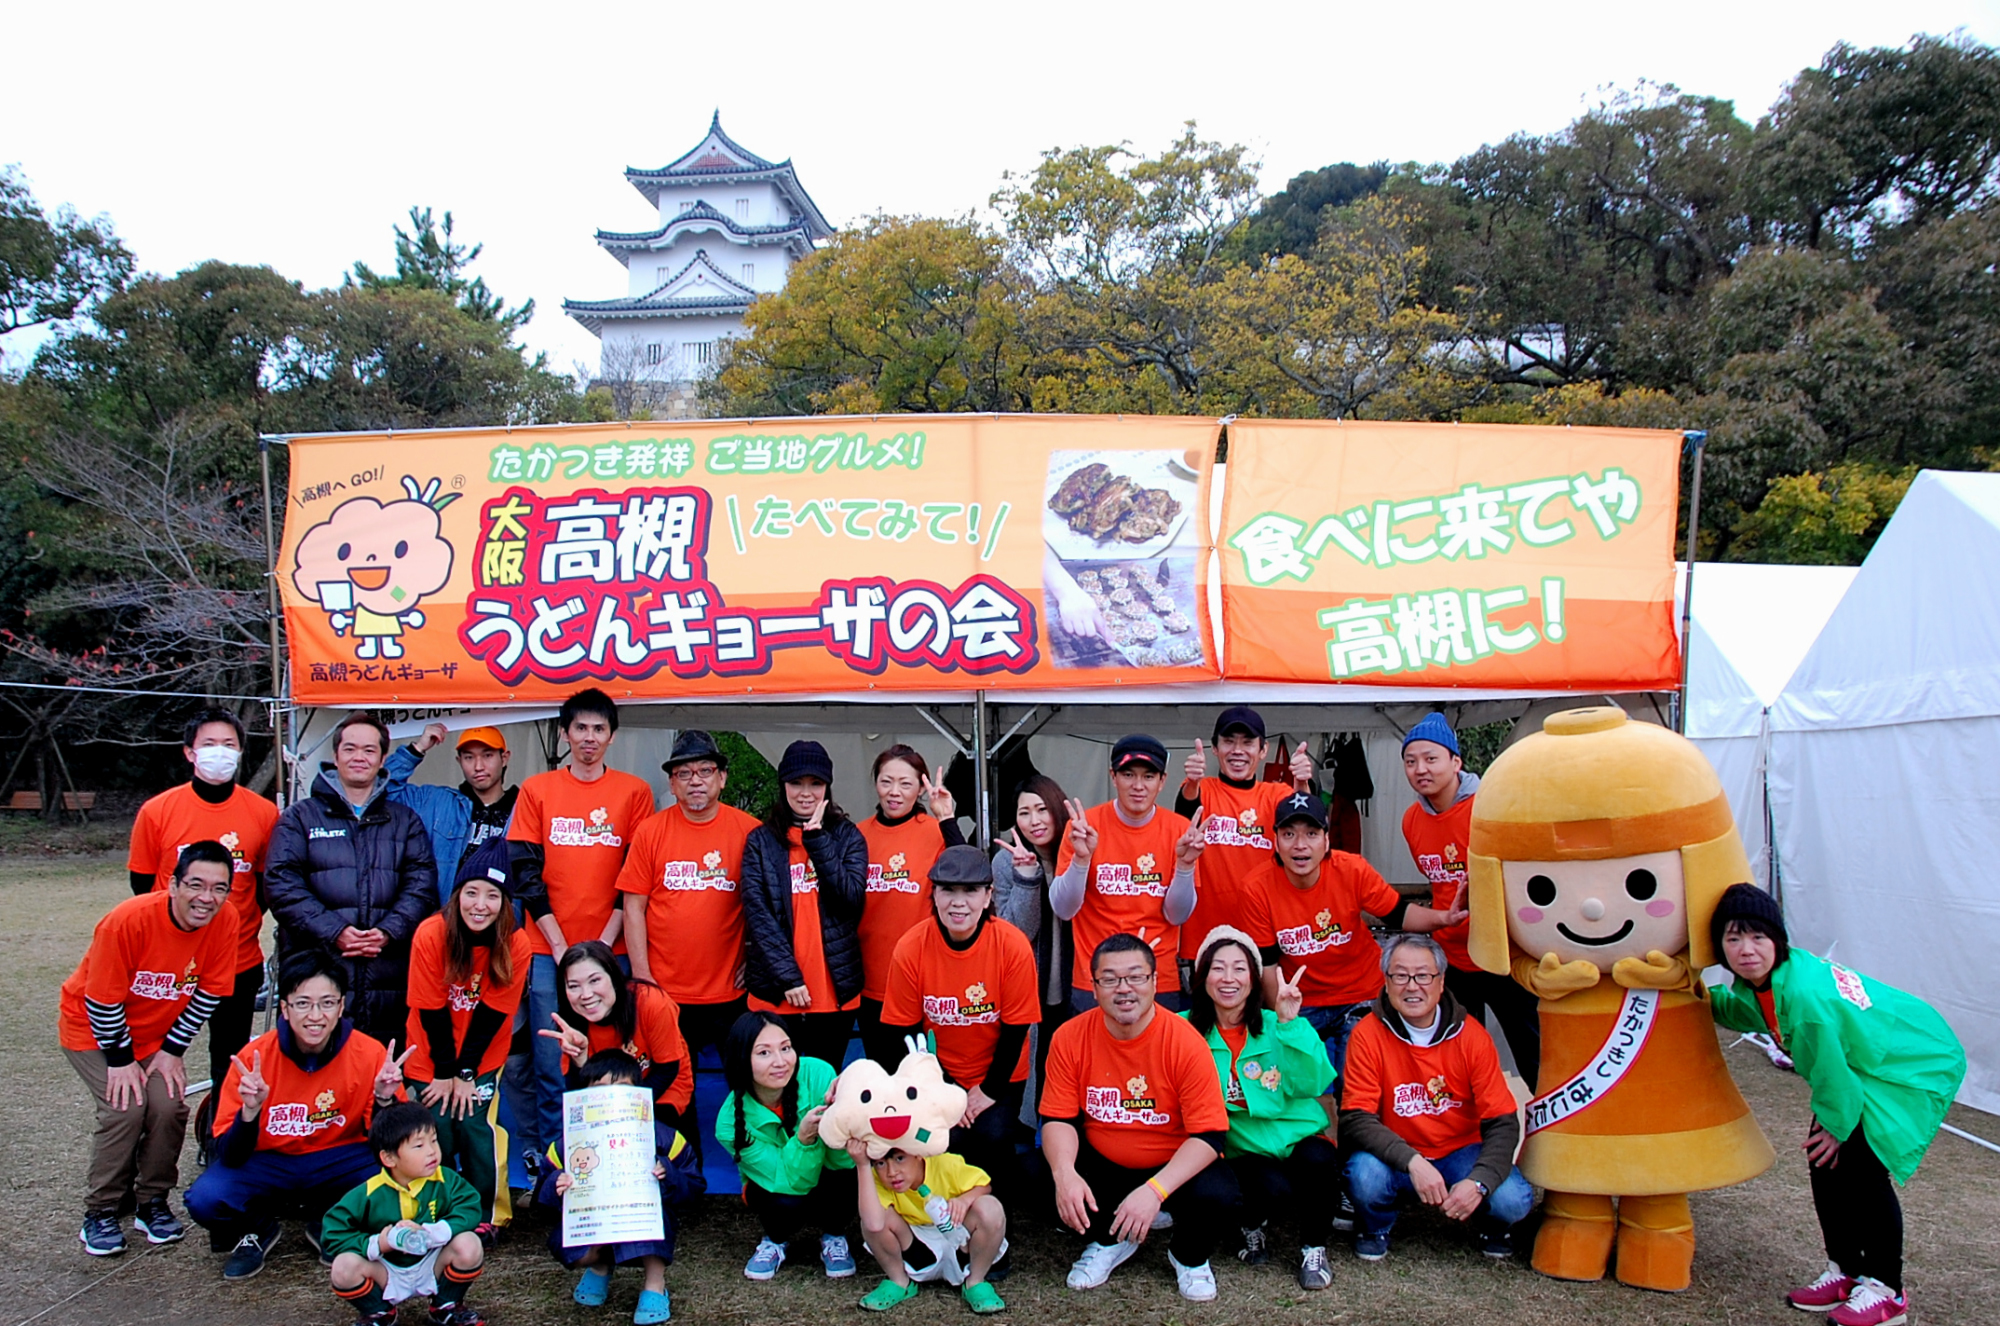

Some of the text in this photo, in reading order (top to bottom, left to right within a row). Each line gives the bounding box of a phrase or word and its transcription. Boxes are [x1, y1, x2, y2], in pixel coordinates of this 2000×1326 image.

[492, 436, 924, 479] たかつき発祥 ご当地グルメ!
[301, 481, 346, 503] 高槻へ
[751, 496, 980, 543] たべてみて!
[1233, 471, 1638, 583] 食べに来てや
[481, 497, 695, 585] 大阪 高槻
[467, 585, 1021, 670] うどんギョーザの会
[1321, 580, 1564, 676] 高槻に!
[310, 662, 458, 682] 高槻うどんギョーザ
[553, 820, 582, 833] 高槻
[586, 825, 612, 834] OSAKA
[667, 863, 695, 877] 高槻
[699, 869, 726, 878] OSAKA
[868, 866, 881, 880] 槻
[883, 871, 908, 879] OSAKA
[1098, 866, 1129, 882] 高槻
[1132, 873, 1160, 882] OSAKA
[1279, 927, 1309, 945] 高槻
[1314, 924, 1340, 940] OSAKA
[135, 973, 175, 989] 高槻
[961, 1004, 993, 1015] OSAKA
[1596, 995, 1649, 1078] たかつきし
[1087, 1089, 1118, 1108] 高槻
[1396, 1085, 1426, 1104] 高槻
[1123, 1099, 1154, 1108] OSAKA
[271, 1106, 305, 1122] 高槻
[309, 1110, 338, 1121] OSAKA
